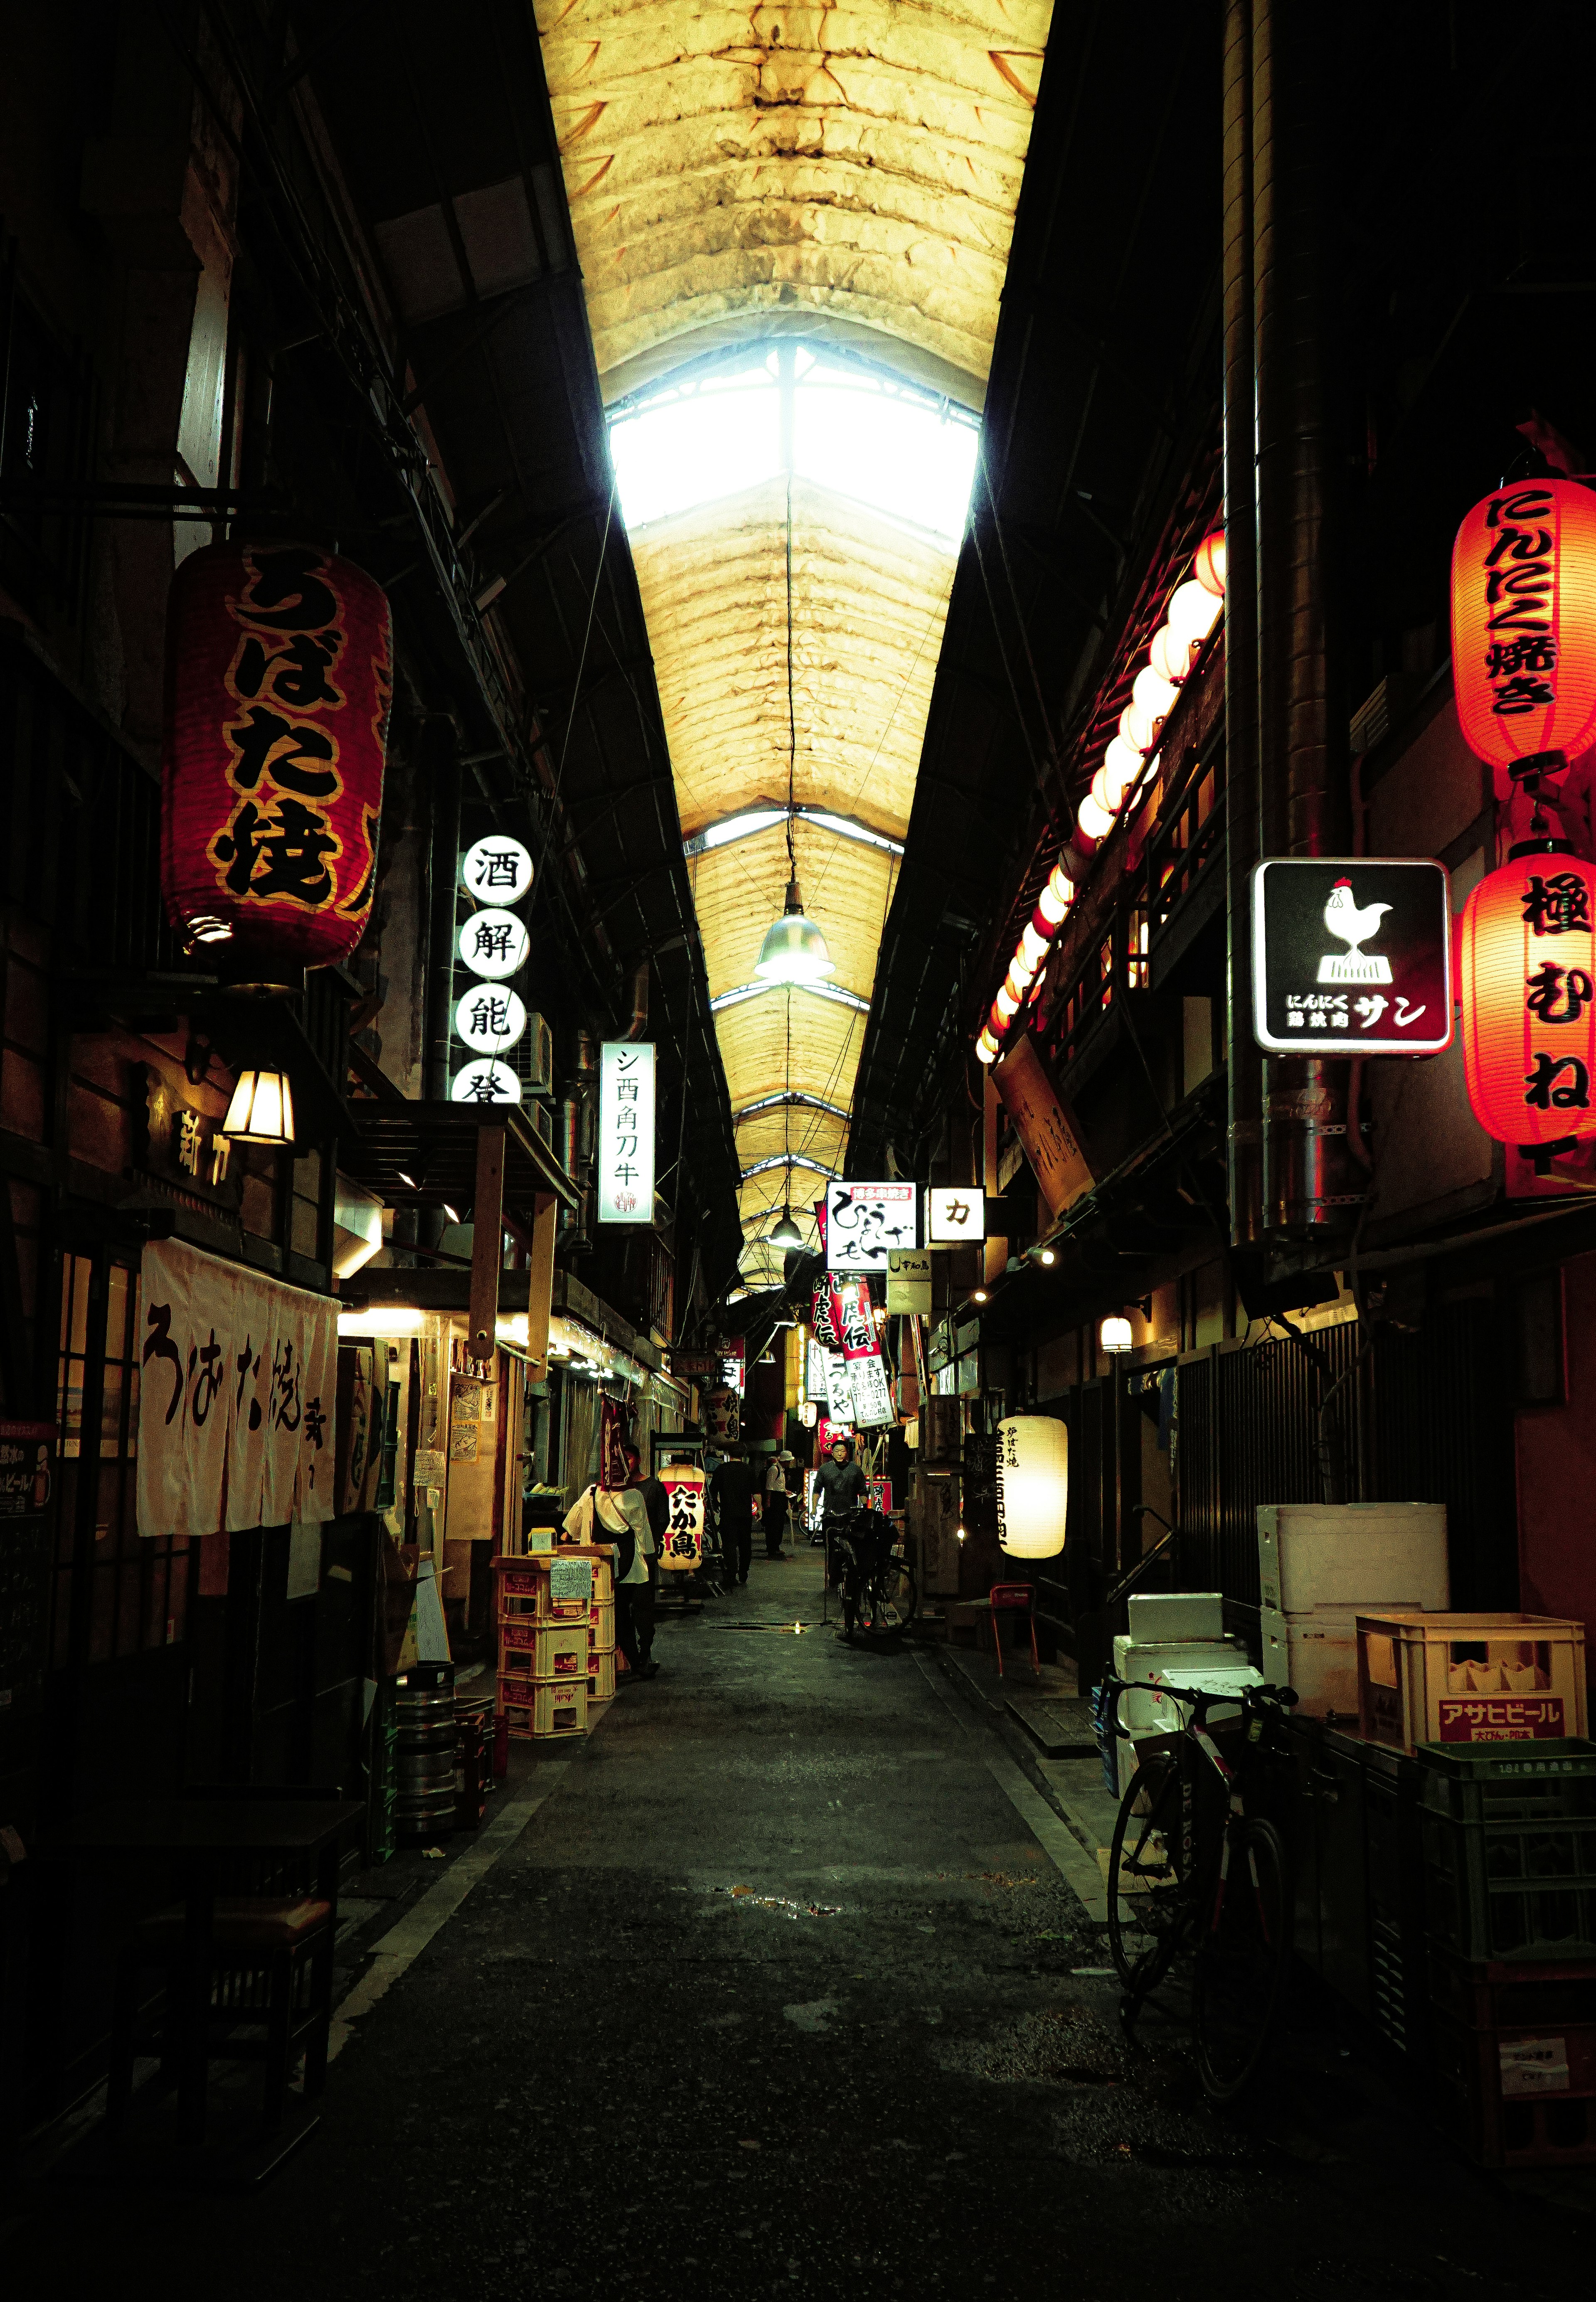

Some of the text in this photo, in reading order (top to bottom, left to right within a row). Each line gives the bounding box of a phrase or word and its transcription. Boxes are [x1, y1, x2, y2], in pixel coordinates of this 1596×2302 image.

[1485, 490, 1558, 715] にんにく焼き
[213, 547, 342, 907] ろばた焼
[1288, 995, 1426, 1028] にんにく サン
[1523, 872, 1594, 1110] 極むね
[143, 1303, 301, 1431] ろばた焼
[851, 1368, 882, 1382] 承ります
[853, 1359, 876, 1371] 宴会
[1007, 1426, 1019, 1467] 炉ばた焼
[670, 1487, 697, 1559] たか鳥
[1443, 1704, 1560, 1724] アサヒビール
